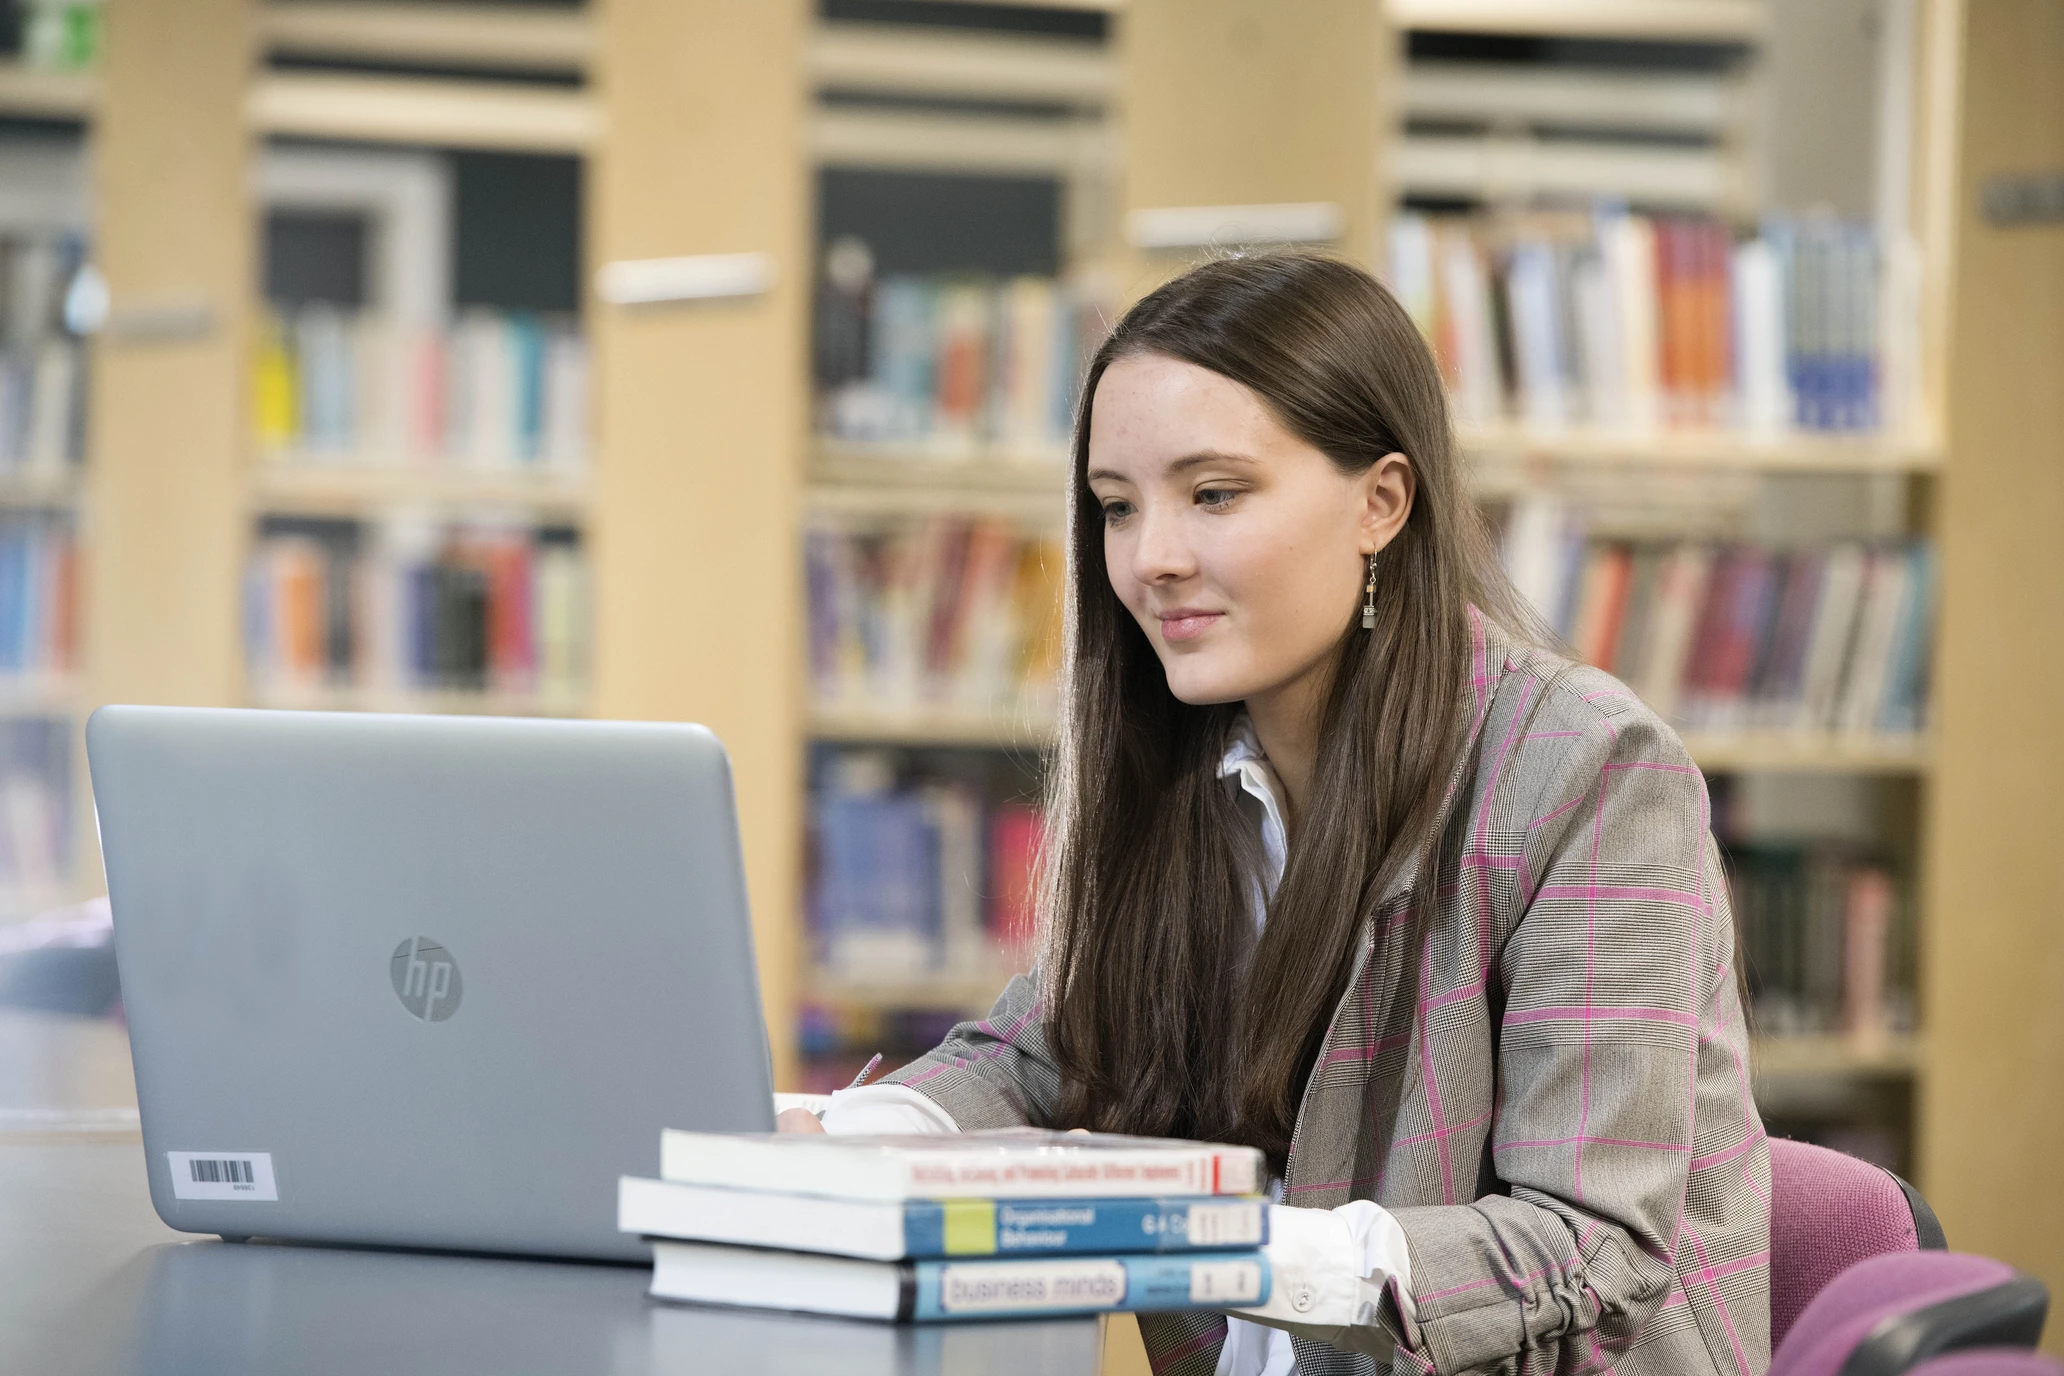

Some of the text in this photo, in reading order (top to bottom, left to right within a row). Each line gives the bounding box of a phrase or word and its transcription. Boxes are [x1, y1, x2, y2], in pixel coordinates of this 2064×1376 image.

[402, 936, 453, 1021] hp
[950, 1278, 1046, 1303] business
[1053, 1275, 1118, 1300] minds
